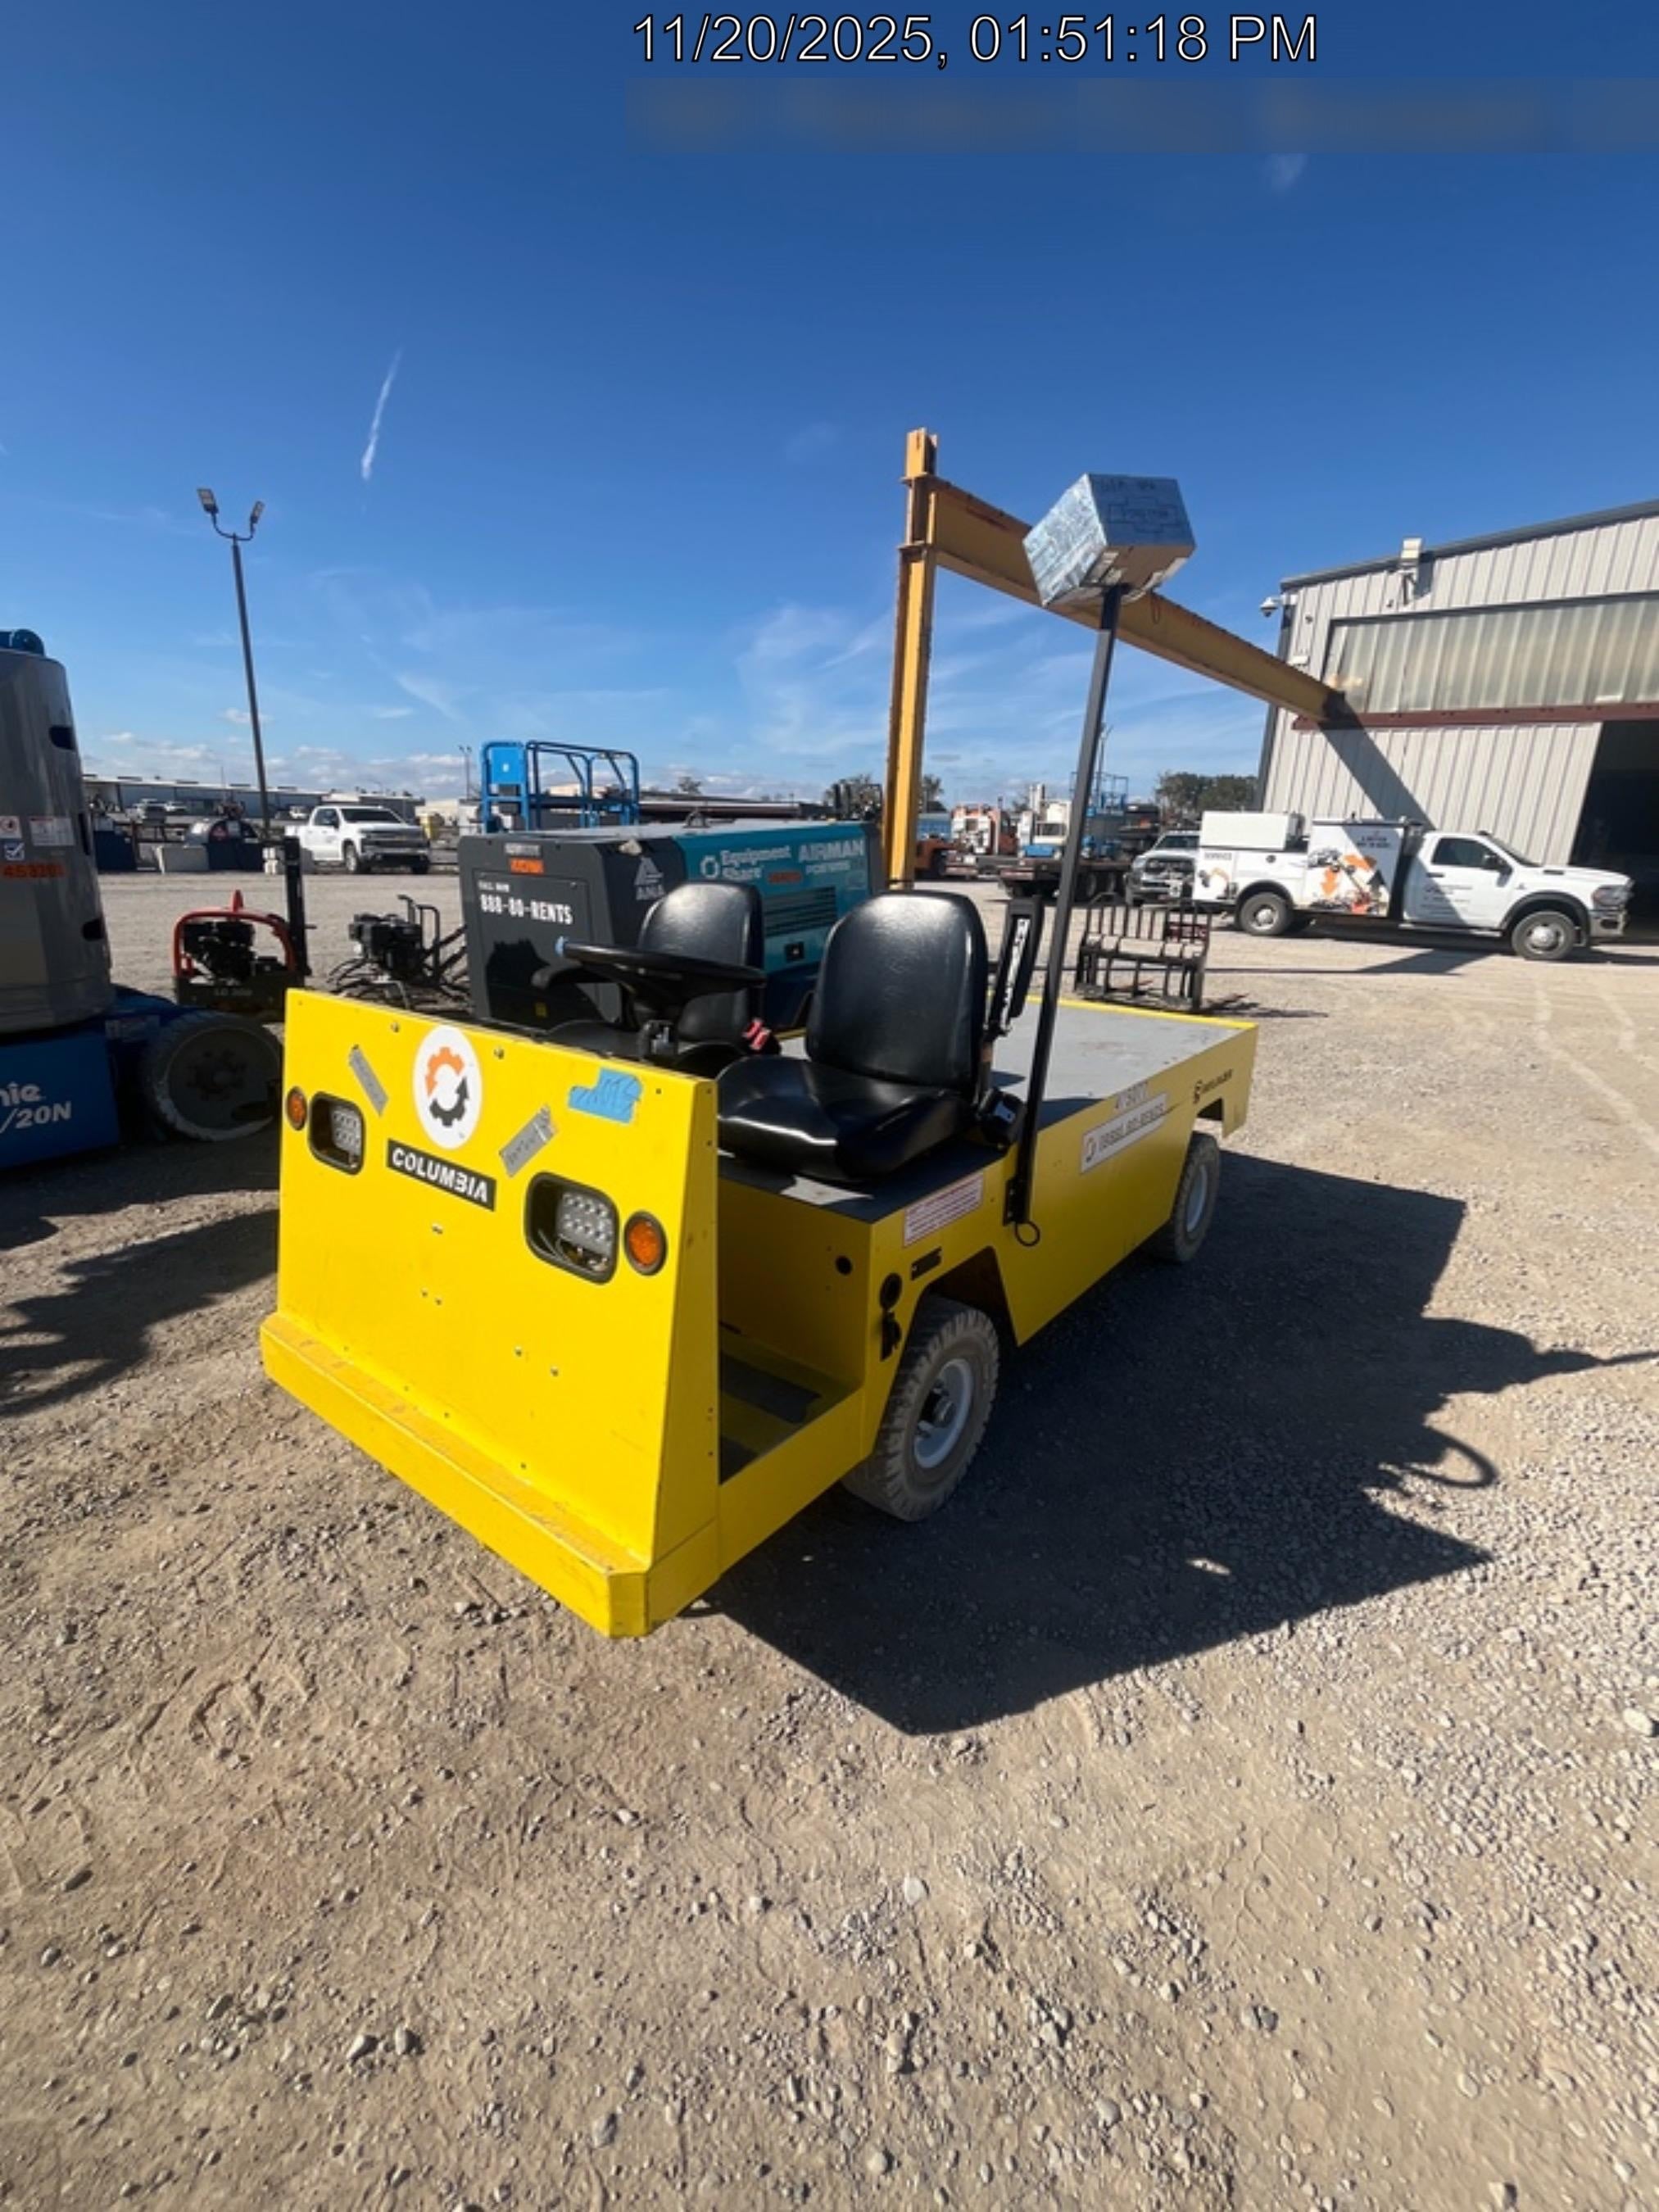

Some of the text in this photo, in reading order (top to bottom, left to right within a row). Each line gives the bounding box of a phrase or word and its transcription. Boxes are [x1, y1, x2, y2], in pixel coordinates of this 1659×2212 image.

[720, 845, 791, 867] Equipment
[799, 839, 865, 863] AIRMAN
[392, 1148, 489, 1203] COLUMBIA
